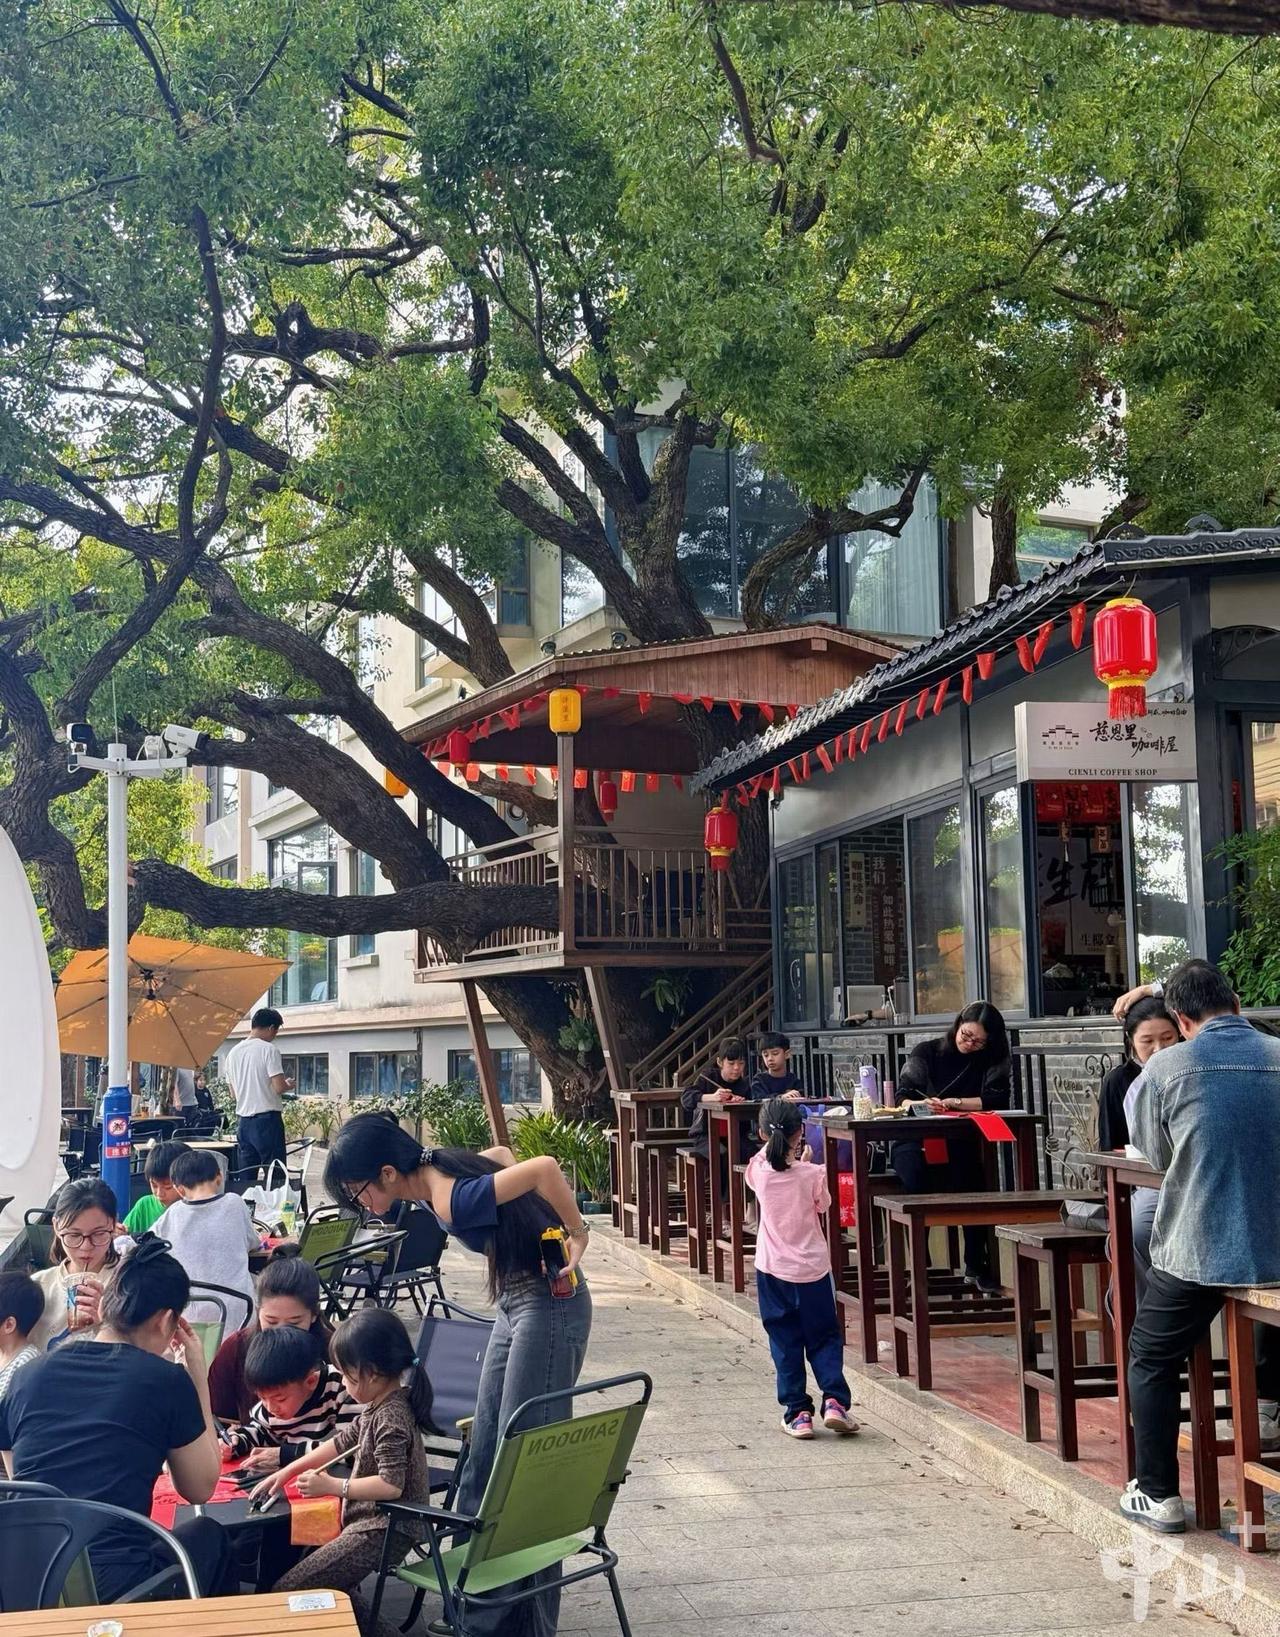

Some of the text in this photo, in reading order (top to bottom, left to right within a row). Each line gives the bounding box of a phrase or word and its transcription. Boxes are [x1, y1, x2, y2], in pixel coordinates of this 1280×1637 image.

[1089, 720, 1137, 742] 慈恩里
[1131, 735, 1179, 758] 咖啡屋
[1068, 768, 1158, 776] CIENLI COFFEE SHOP
[872, 856, 886, 885] 我们
